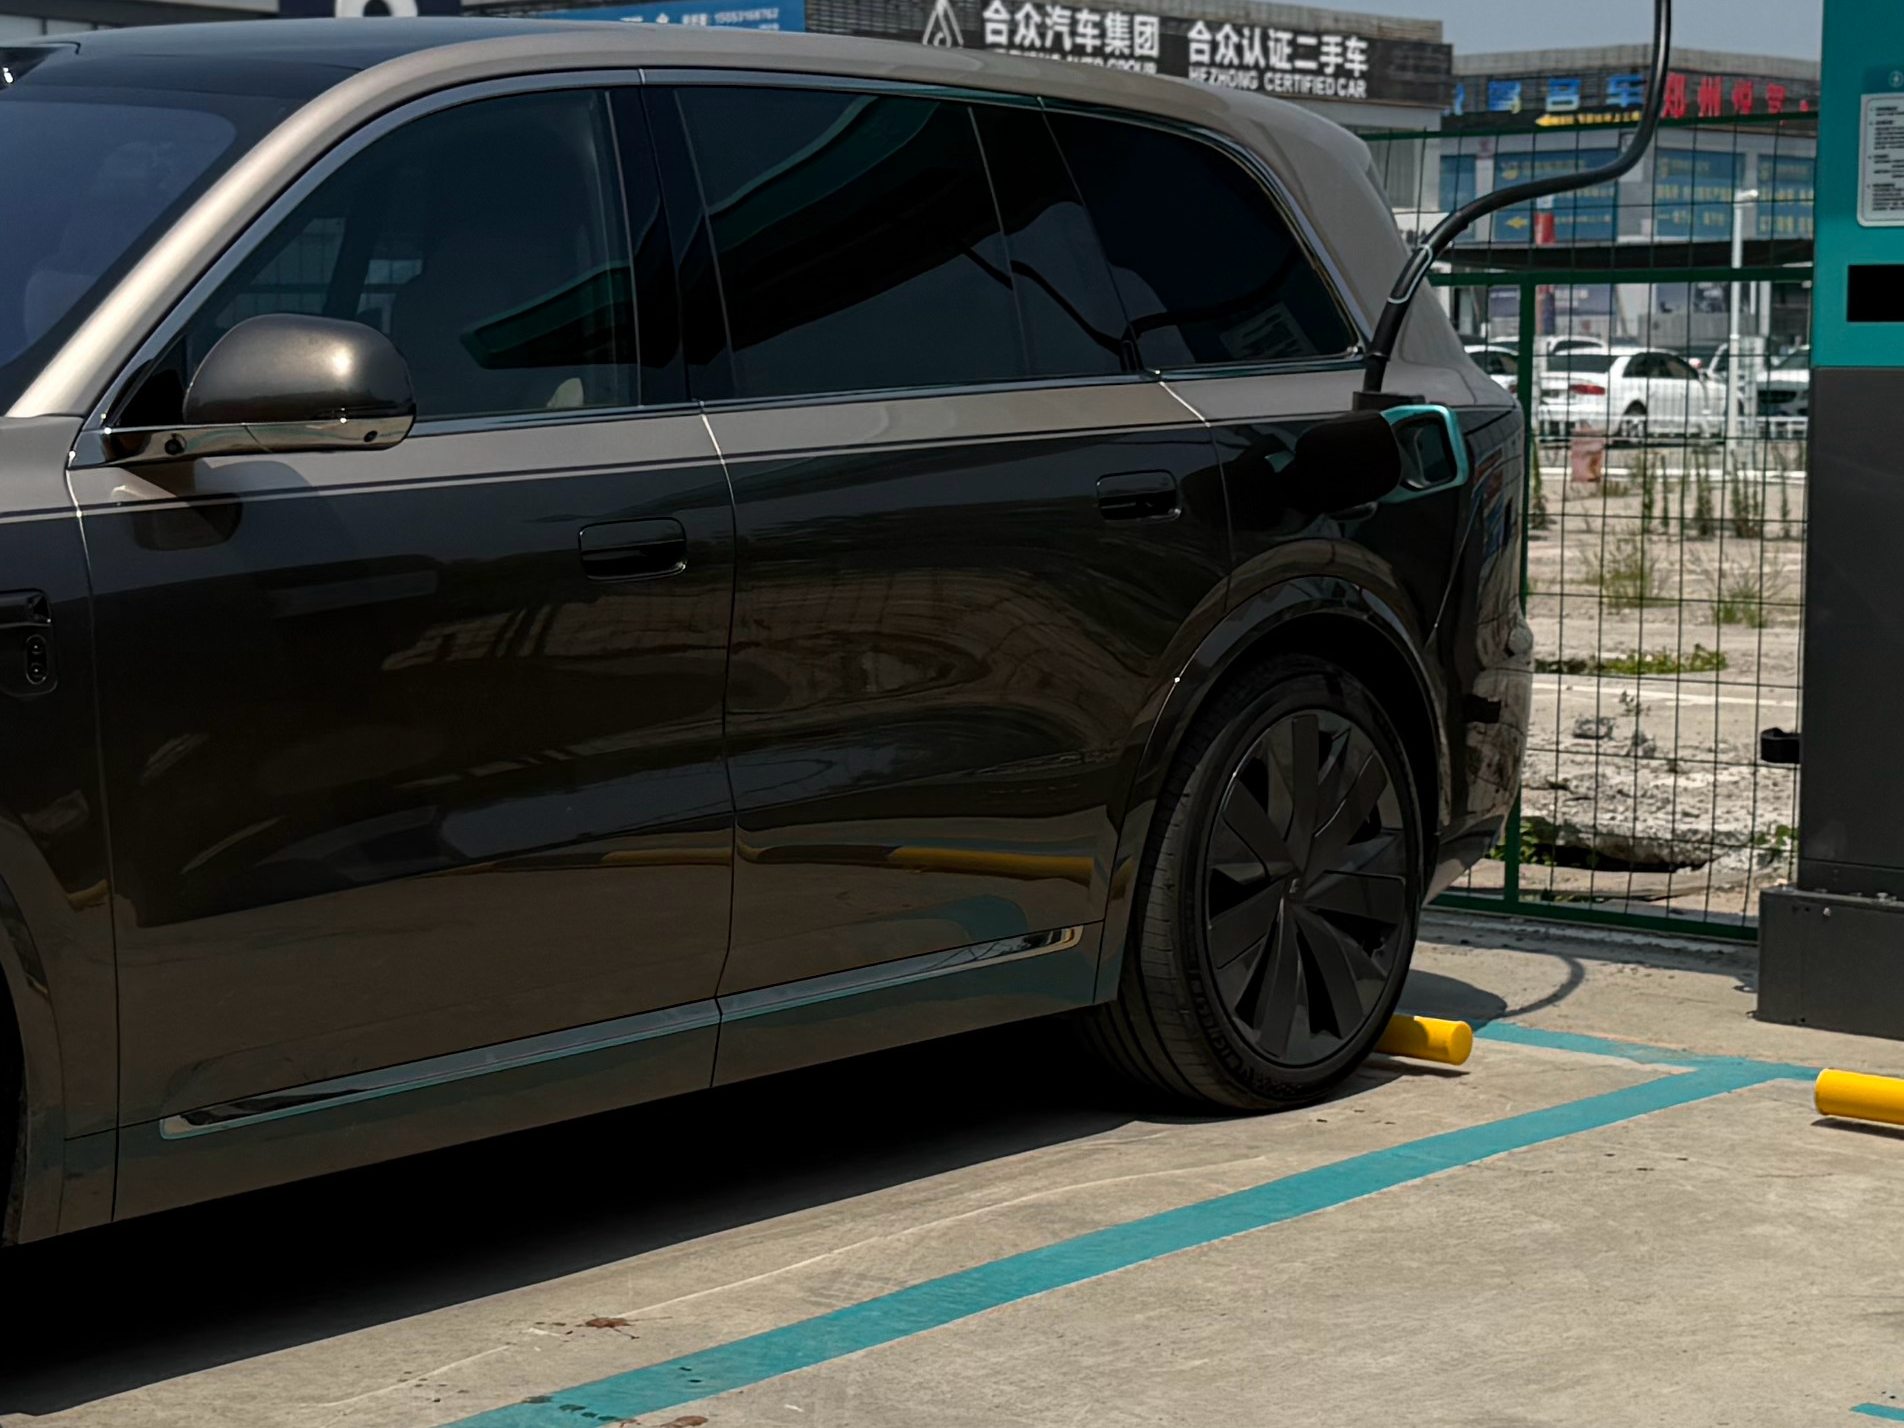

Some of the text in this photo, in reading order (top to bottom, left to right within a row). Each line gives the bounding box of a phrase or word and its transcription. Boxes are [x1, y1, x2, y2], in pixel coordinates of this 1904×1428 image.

[1187, 20, 1369, 78] 合众认证二手车
[1263, 71, 1337, 97] CERTIFIED
[1337, 76, 1367, 99] CAR
